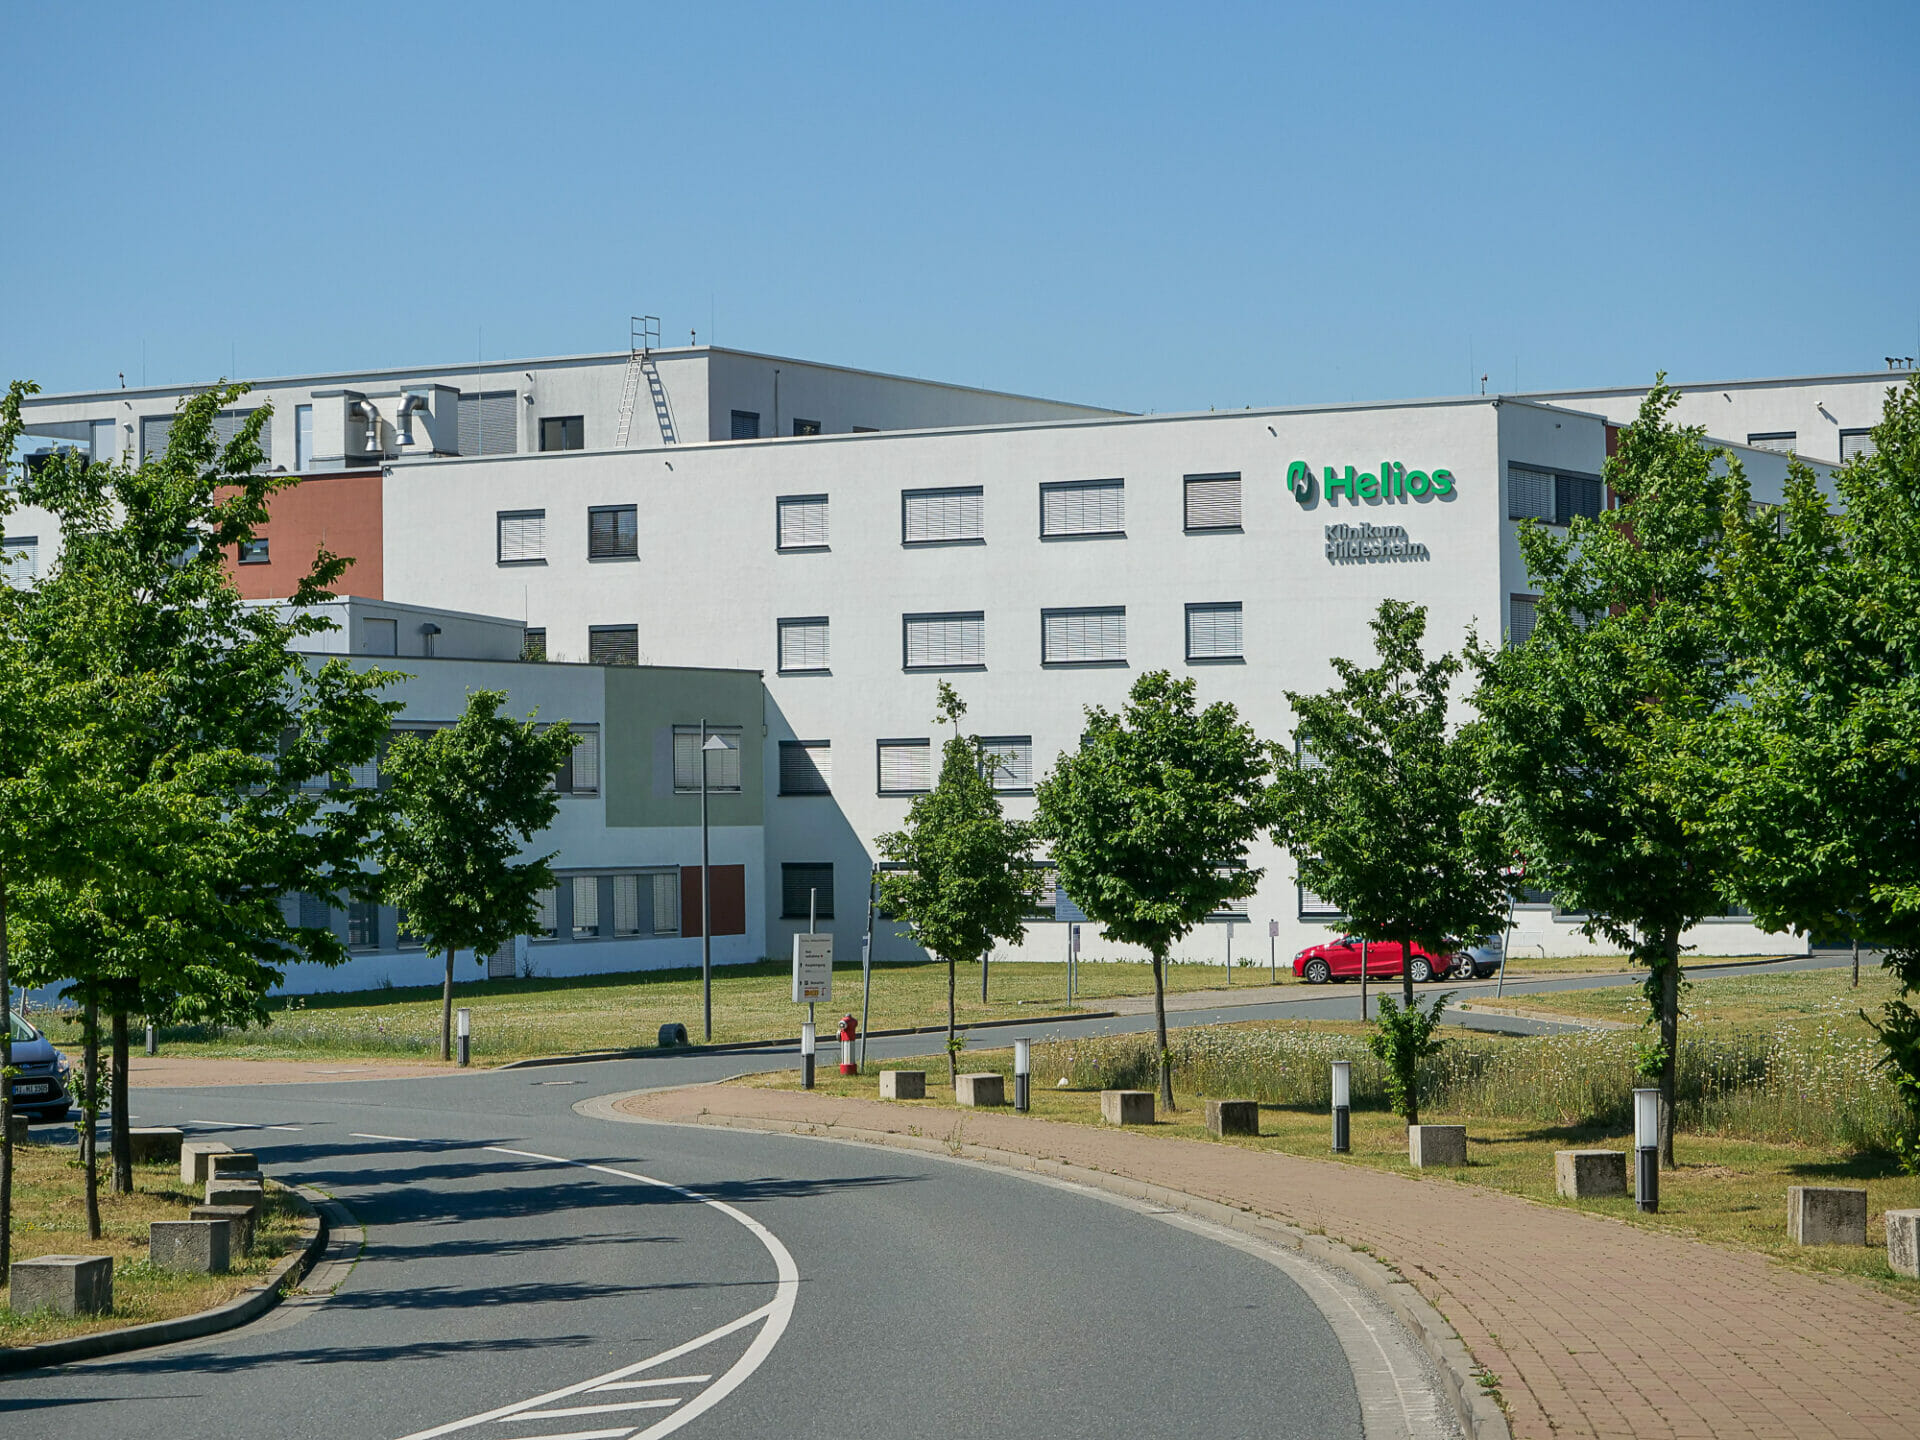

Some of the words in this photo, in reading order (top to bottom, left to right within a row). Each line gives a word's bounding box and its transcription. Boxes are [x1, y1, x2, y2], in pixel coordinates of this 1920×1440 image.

[1324, 461, 1453, 500] Helios
[1324, 522, 1404, 540] Klinikum
[1325, 540, 1426, 558] Hildesheim
